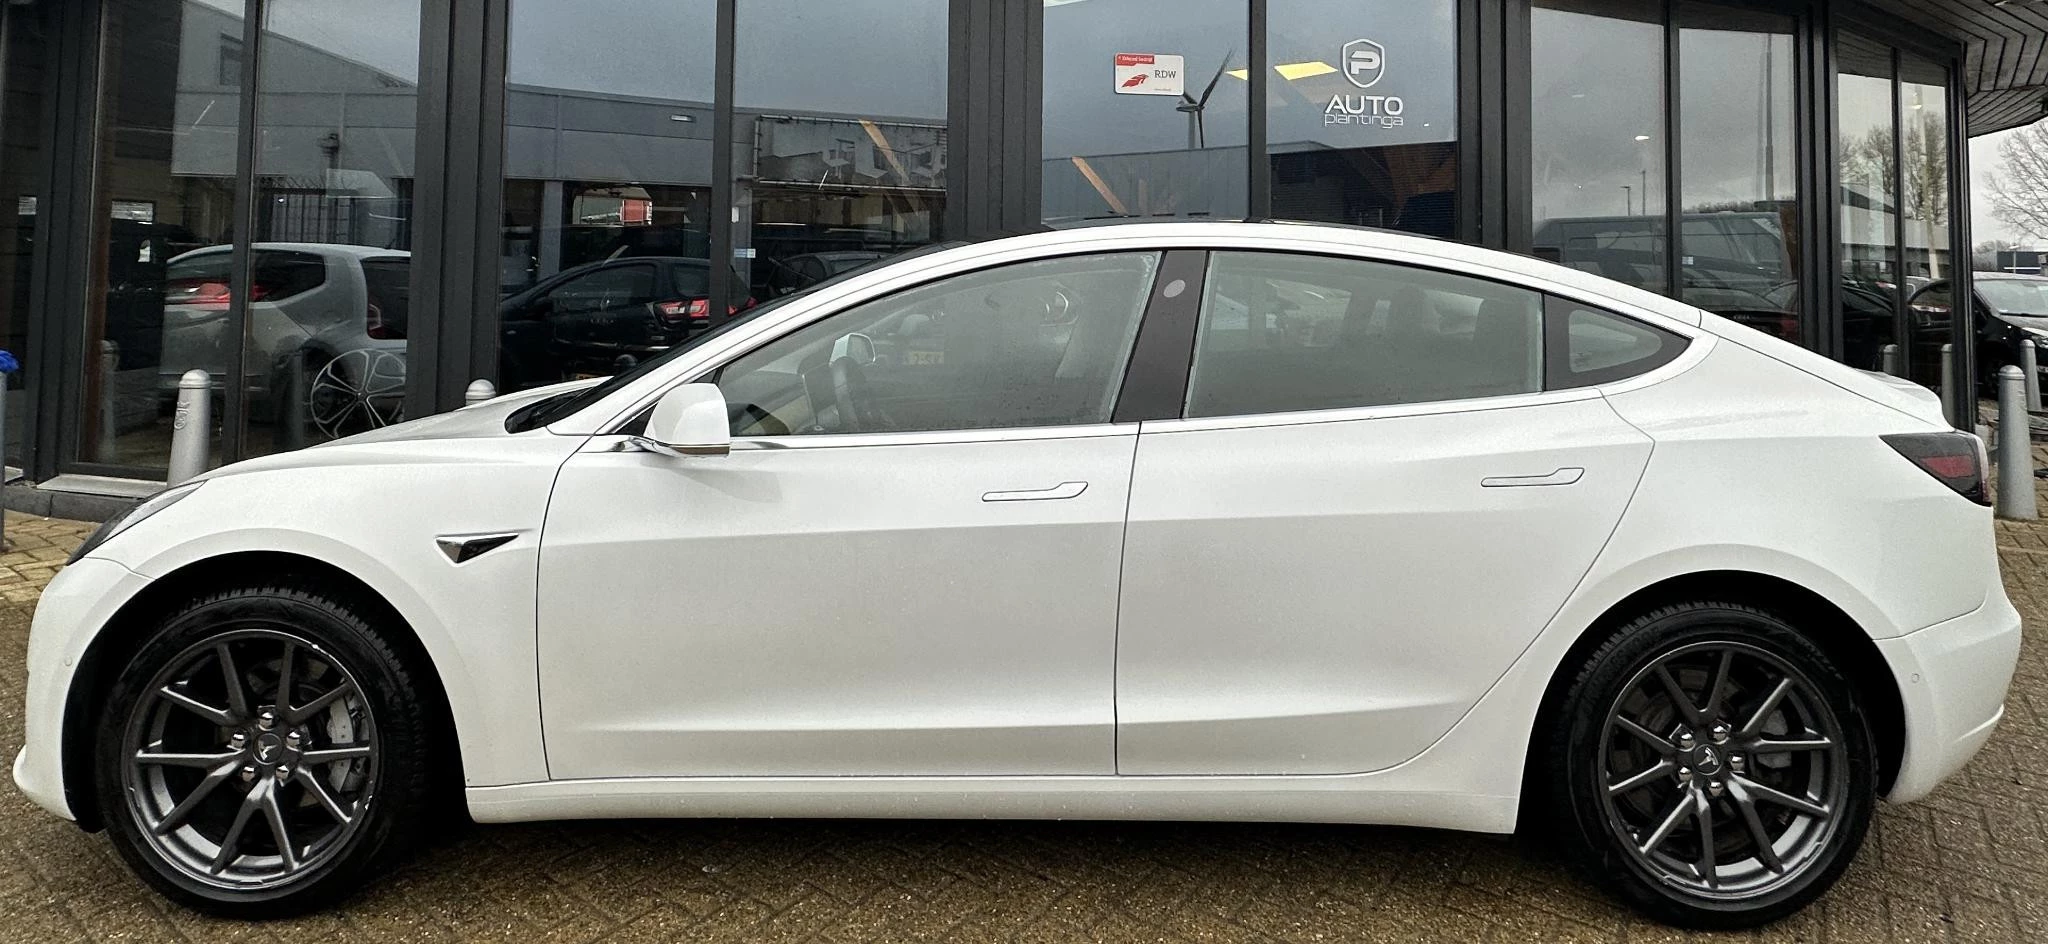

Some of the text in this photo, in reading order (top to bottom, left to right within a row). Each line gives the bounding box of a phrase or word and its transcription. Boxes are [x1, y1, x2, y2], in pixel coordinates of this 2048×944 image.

[1351, 50, 1380, 75] P
[1154, 70, 1176, 79] RDW
[1325, 94, 1403, 115] AUTO
[1325, 113, 1403, 129] plantinga
